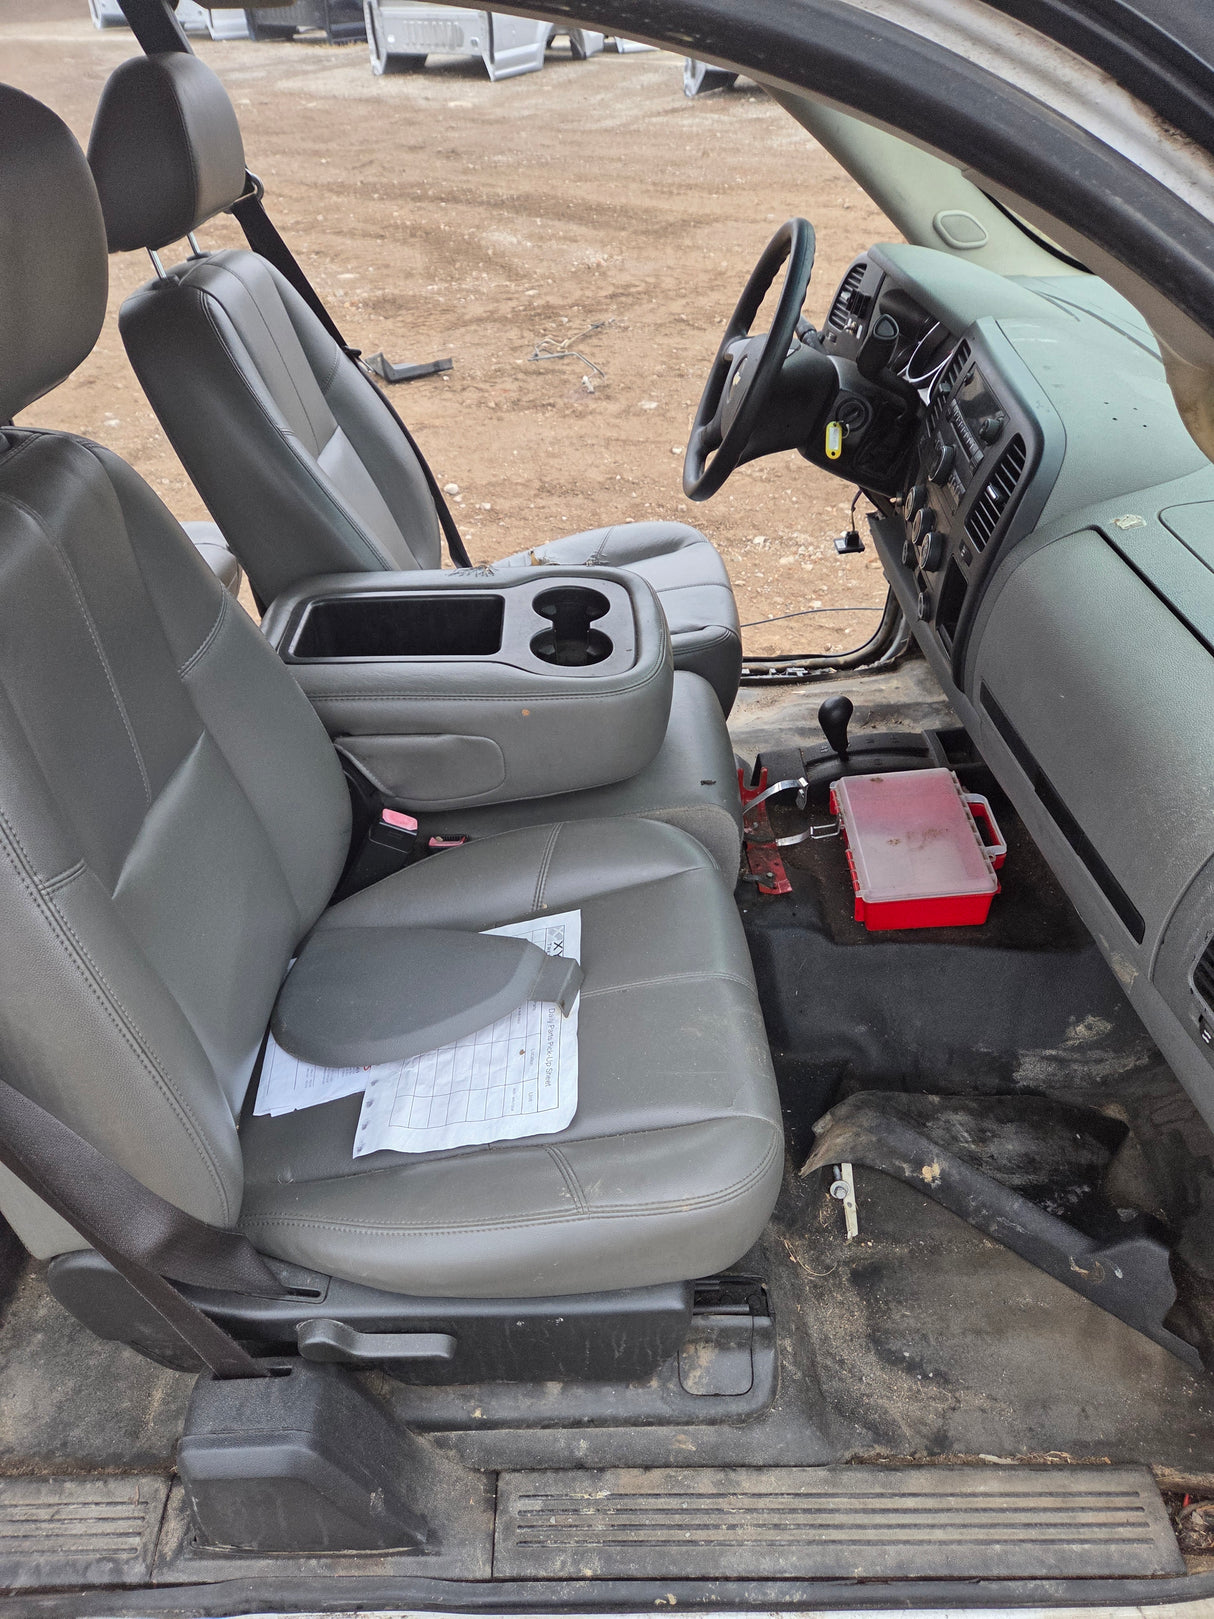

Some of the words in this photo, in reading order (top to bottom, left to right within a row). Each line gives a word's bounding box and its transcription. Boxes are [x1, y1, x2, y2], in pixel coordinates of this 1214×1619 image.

[547, 1007, 555, 1023] Daily
[547, 1024, 555, 1041] Parts
[545, 1041, 553, 1067] Pick-Up
[545, 1067, 553, 1087] Sheet
